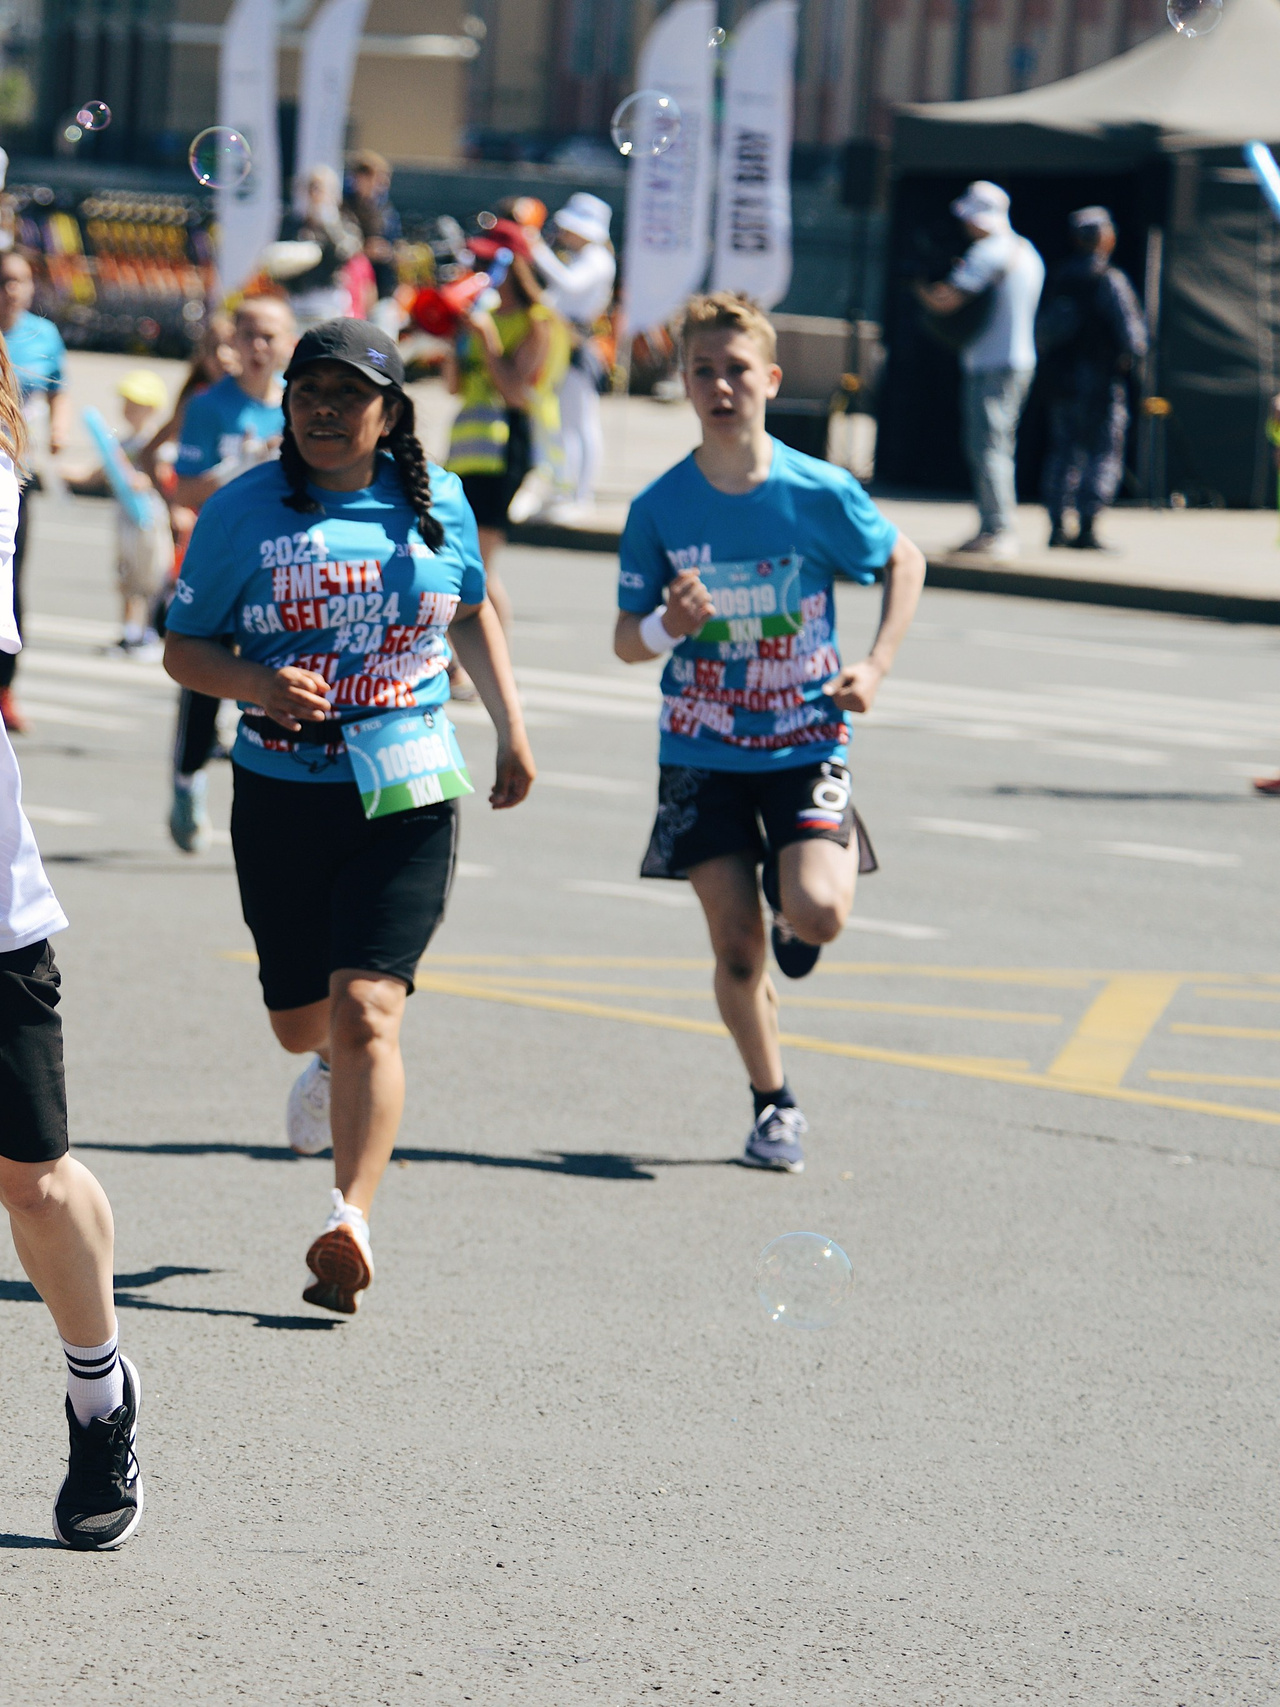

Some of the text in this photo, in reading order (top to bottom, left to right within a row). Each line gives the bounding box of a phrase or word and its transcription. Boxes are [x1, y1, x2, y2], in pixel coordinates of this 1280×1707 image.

[260, 529, 330, 568] 2024
[272, 560, 384, 602] #МЕЧТА
[242, 592, 401, 634] #ЗАБЕГ2024
